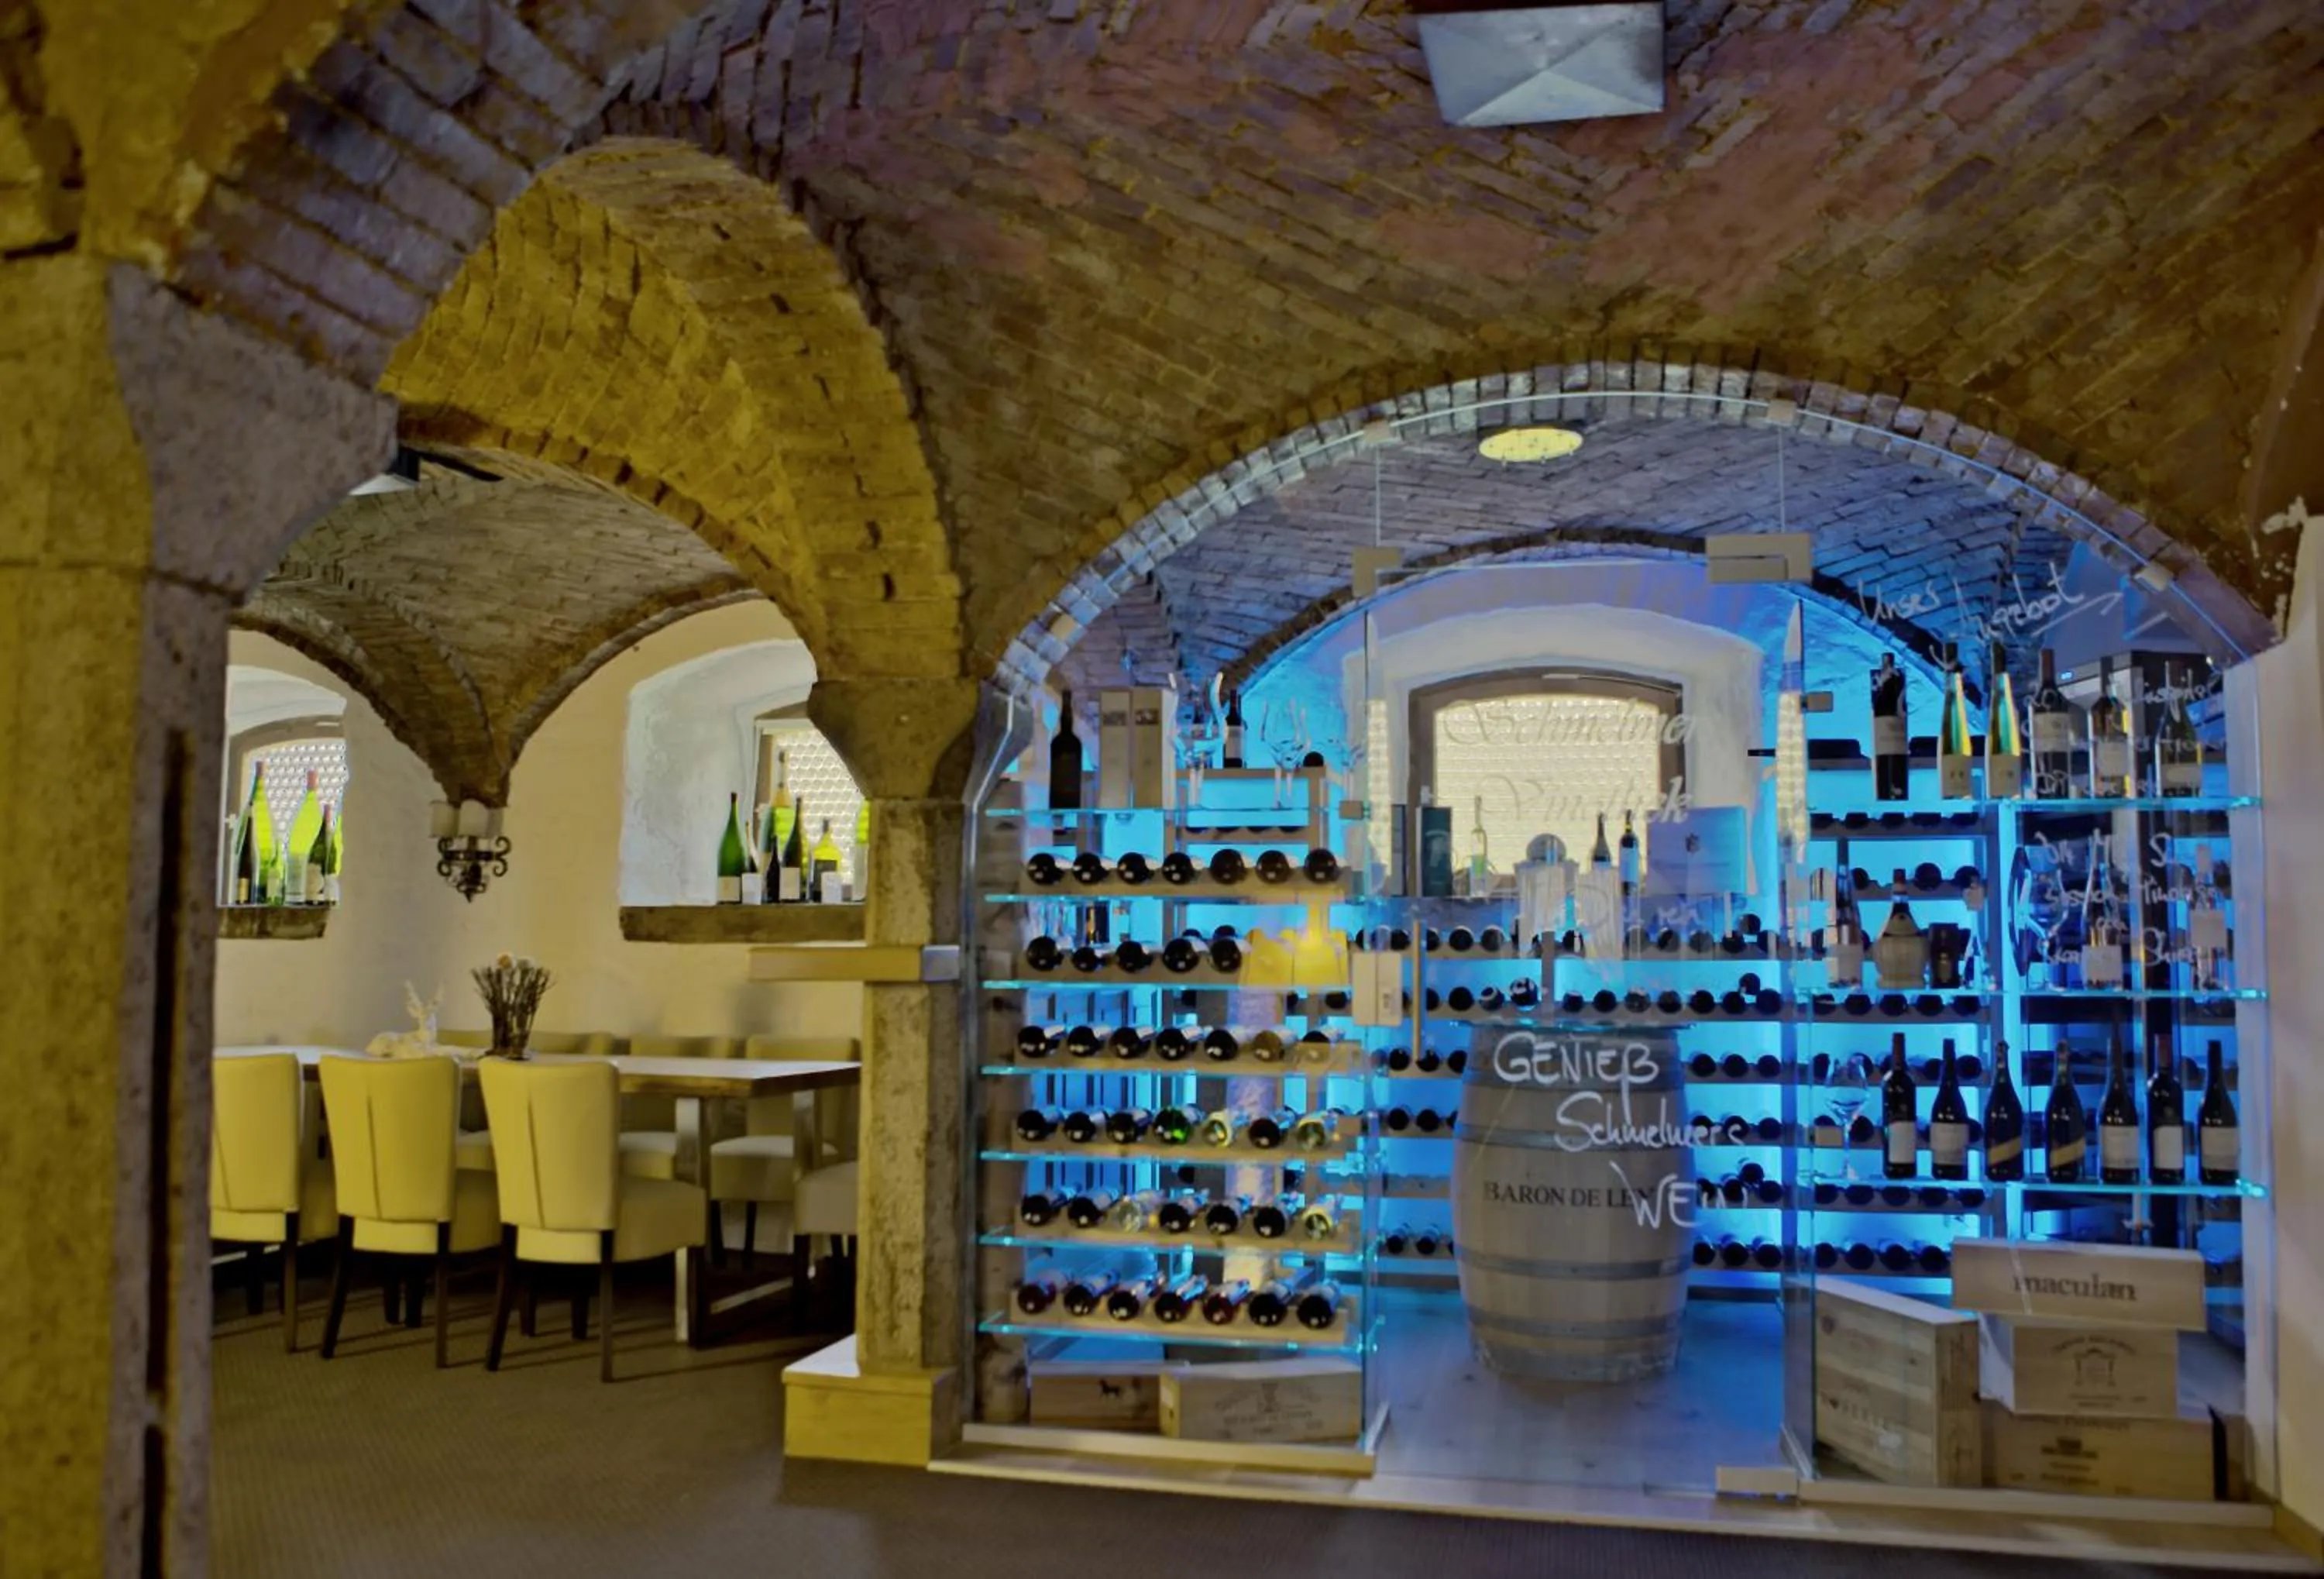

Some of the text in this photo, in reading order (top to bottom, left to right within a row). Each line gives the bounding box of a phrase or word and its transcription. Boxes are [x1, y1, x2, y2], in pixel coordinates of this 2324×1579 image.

[1483, 1181, 1566, 1206] BARON
[1570, 1187, 1600, 1207] DE
[2012, 1271, 2138, 1302] maculan
